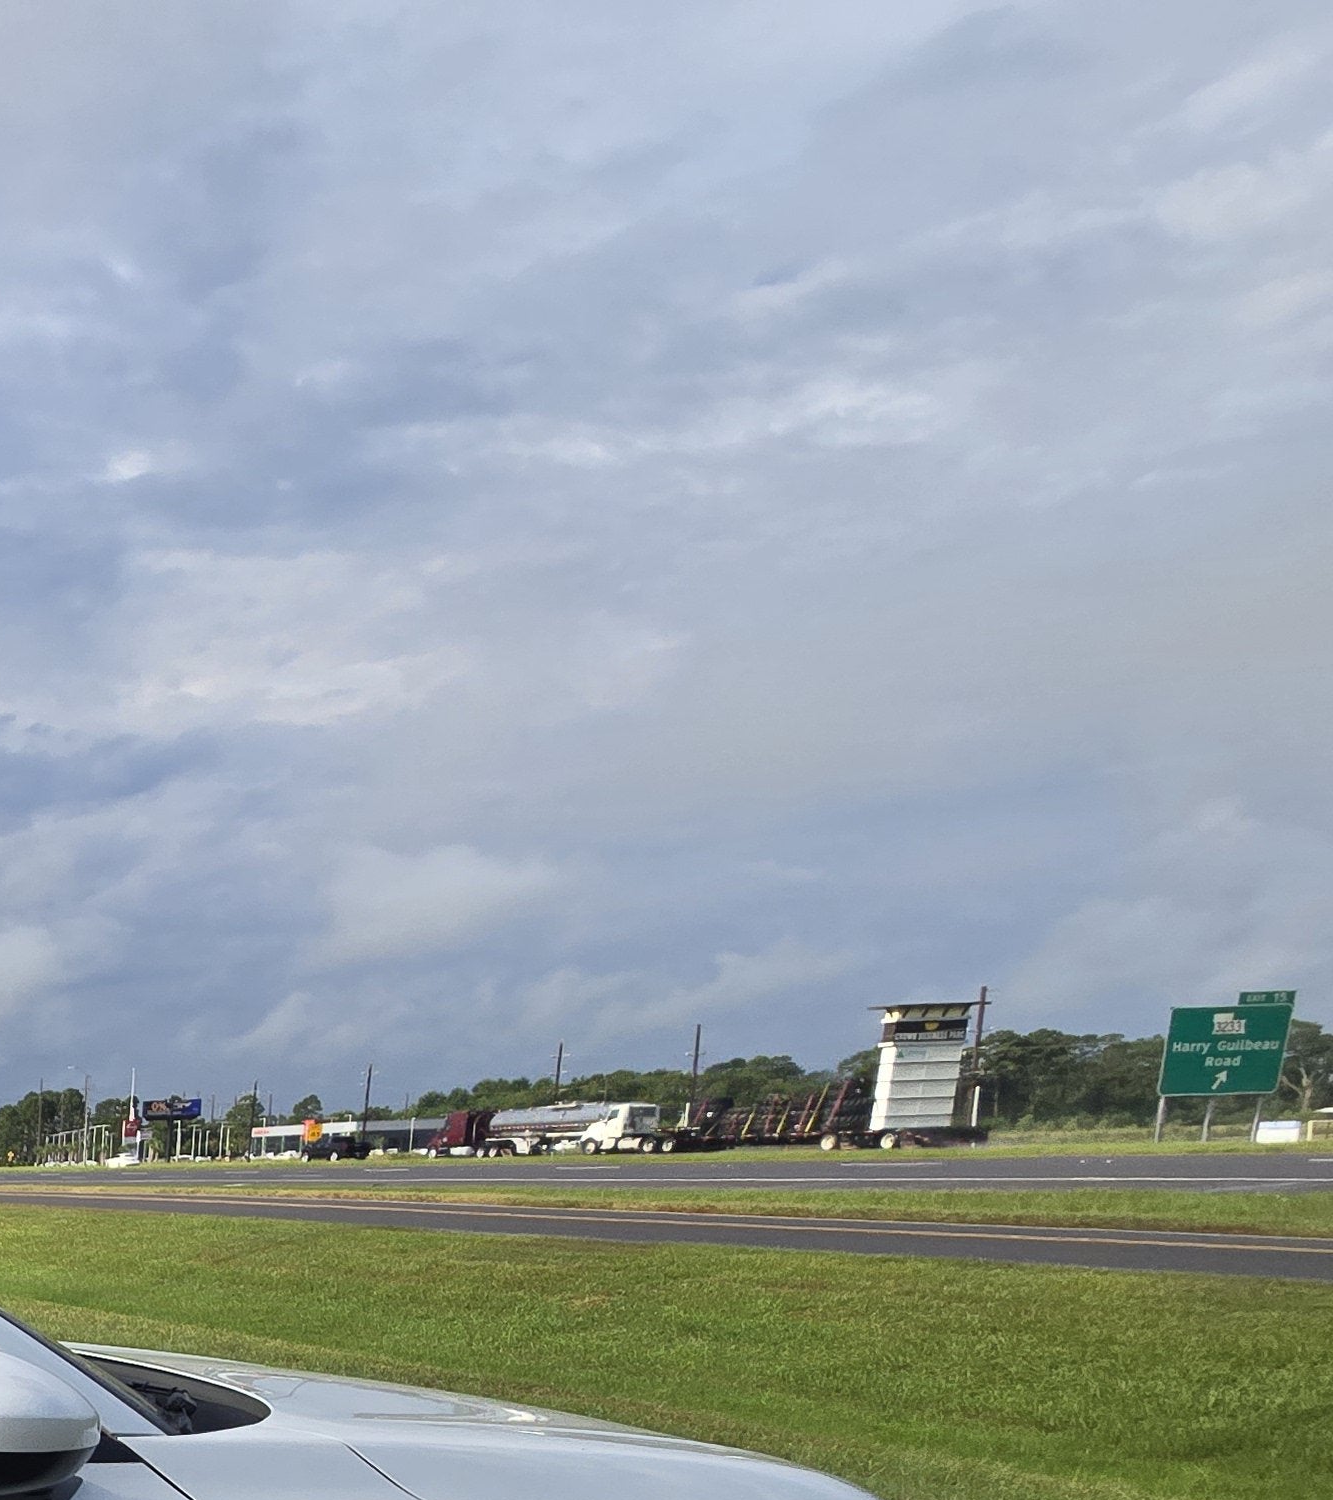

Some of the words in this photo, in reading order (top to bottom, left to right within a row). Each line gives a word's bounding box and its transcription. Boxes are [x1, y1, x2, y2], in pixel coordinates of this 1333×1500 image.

[1215, 1021, 1242, 1033] 3233
[1172, 1041, 1212, 1055] Harry
[1217, 1039, 1280, 1052] Guilbeau
[1204, 1055, 1243, 1067] Road
